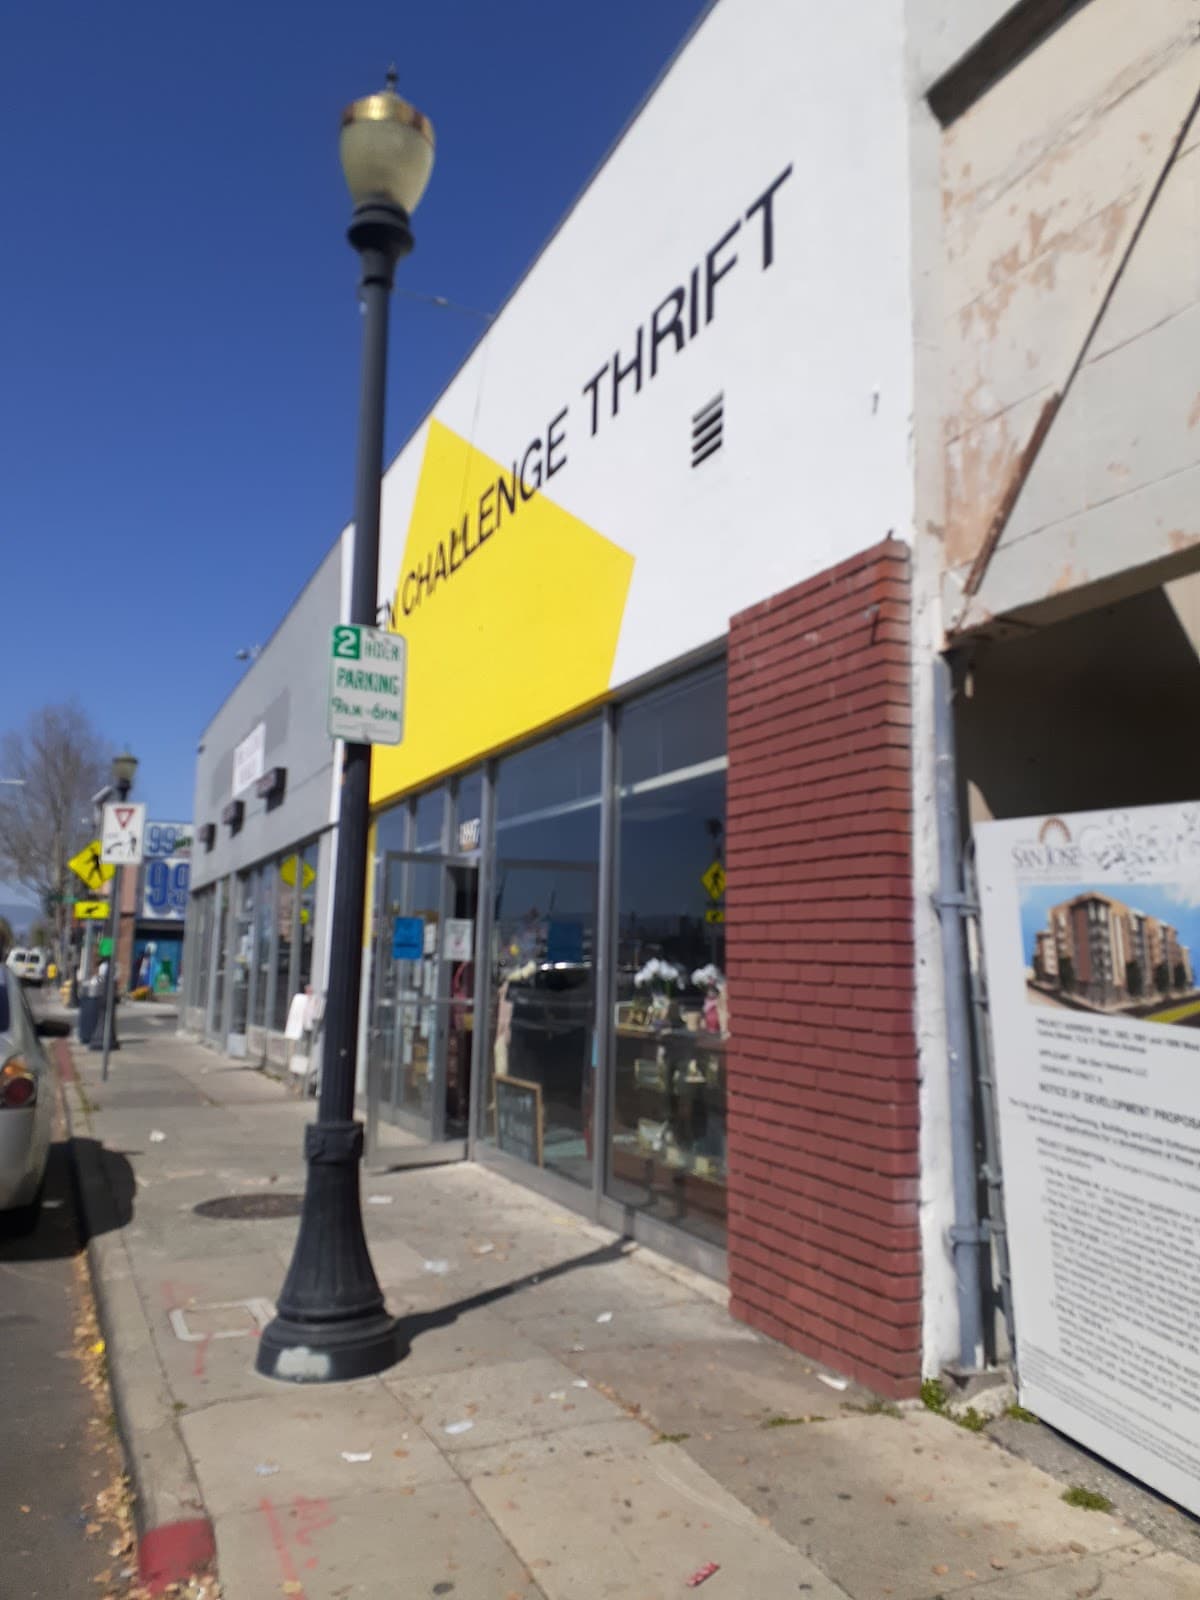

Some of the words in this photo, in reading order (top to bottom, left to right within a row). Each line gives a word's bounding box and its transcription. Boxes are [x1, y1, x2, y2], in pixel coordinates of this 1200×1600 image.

[401, 405, 568, 616] CHALLENGE
[582, 161, 793, 438] THRIFT
[338, 628, 358, 657] 2
[365, 640, 399, 661] HOUR
[336, 666, 399, 696] PARKING
